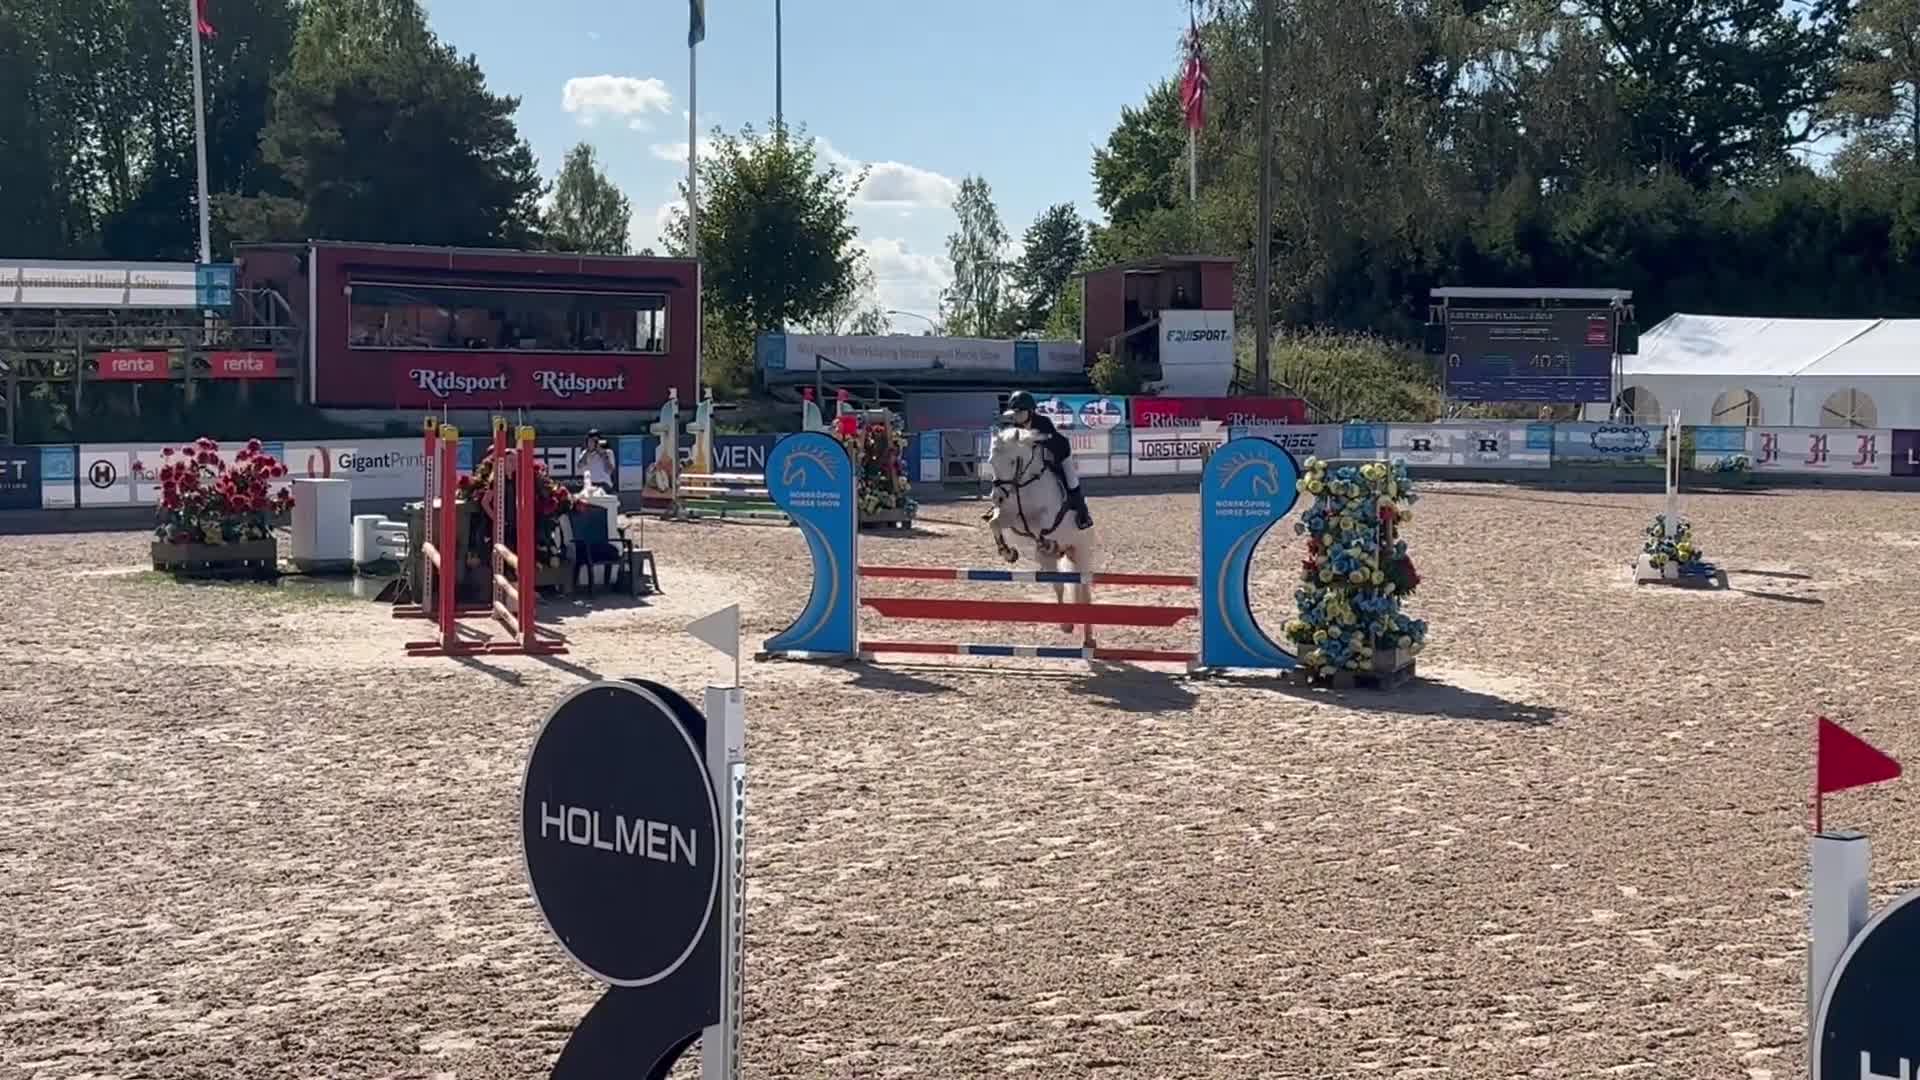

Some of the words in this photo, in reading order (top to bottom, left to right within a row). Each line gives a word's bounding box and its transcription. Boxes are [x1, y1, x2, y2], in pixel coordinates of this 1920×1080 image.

[111, 357, 154, 372] renta
[223, 356, 264, 371] renta
[409, 368, 508, 397] Ridsport
[532, 370, 625, 398] Ridsport
[541, 801, 697, 867] HOLMEN
